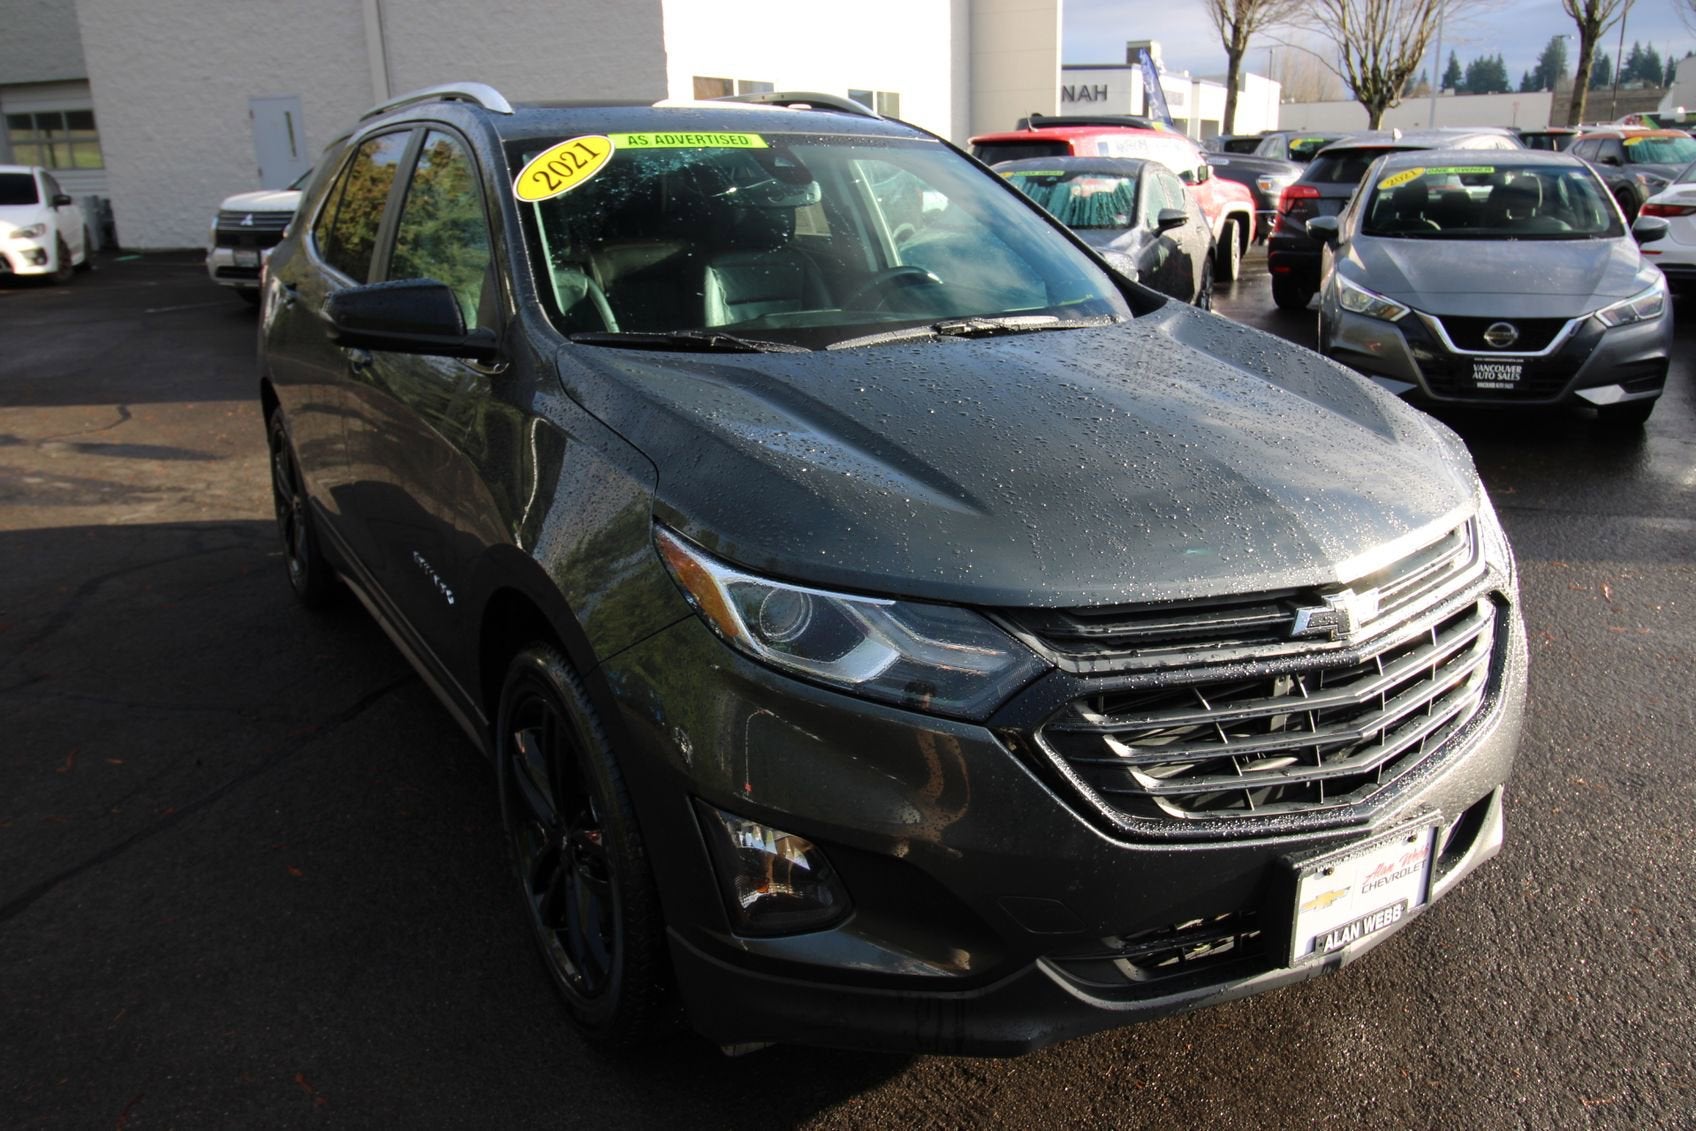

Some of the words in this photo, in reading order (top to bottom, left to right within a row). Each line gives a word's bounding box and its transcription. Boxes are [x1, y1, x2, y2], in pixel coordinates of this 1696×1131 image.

[628, 134, 649, 146] AS
[655, 133, 750, 146] ADVERTISED
[533, 141, 601, 192] 2021
[1472, 371, 1496, 380] AUTO
[1497, 372, 1521, 381] SALES
[1473, 363, 1522, 374] VANCOUVER
[1361, 859, 1428, 894] CHEVROLET
[1323, 922, 1360, 953] ALAN
[1363, 903, 1402, 935] WEBB
